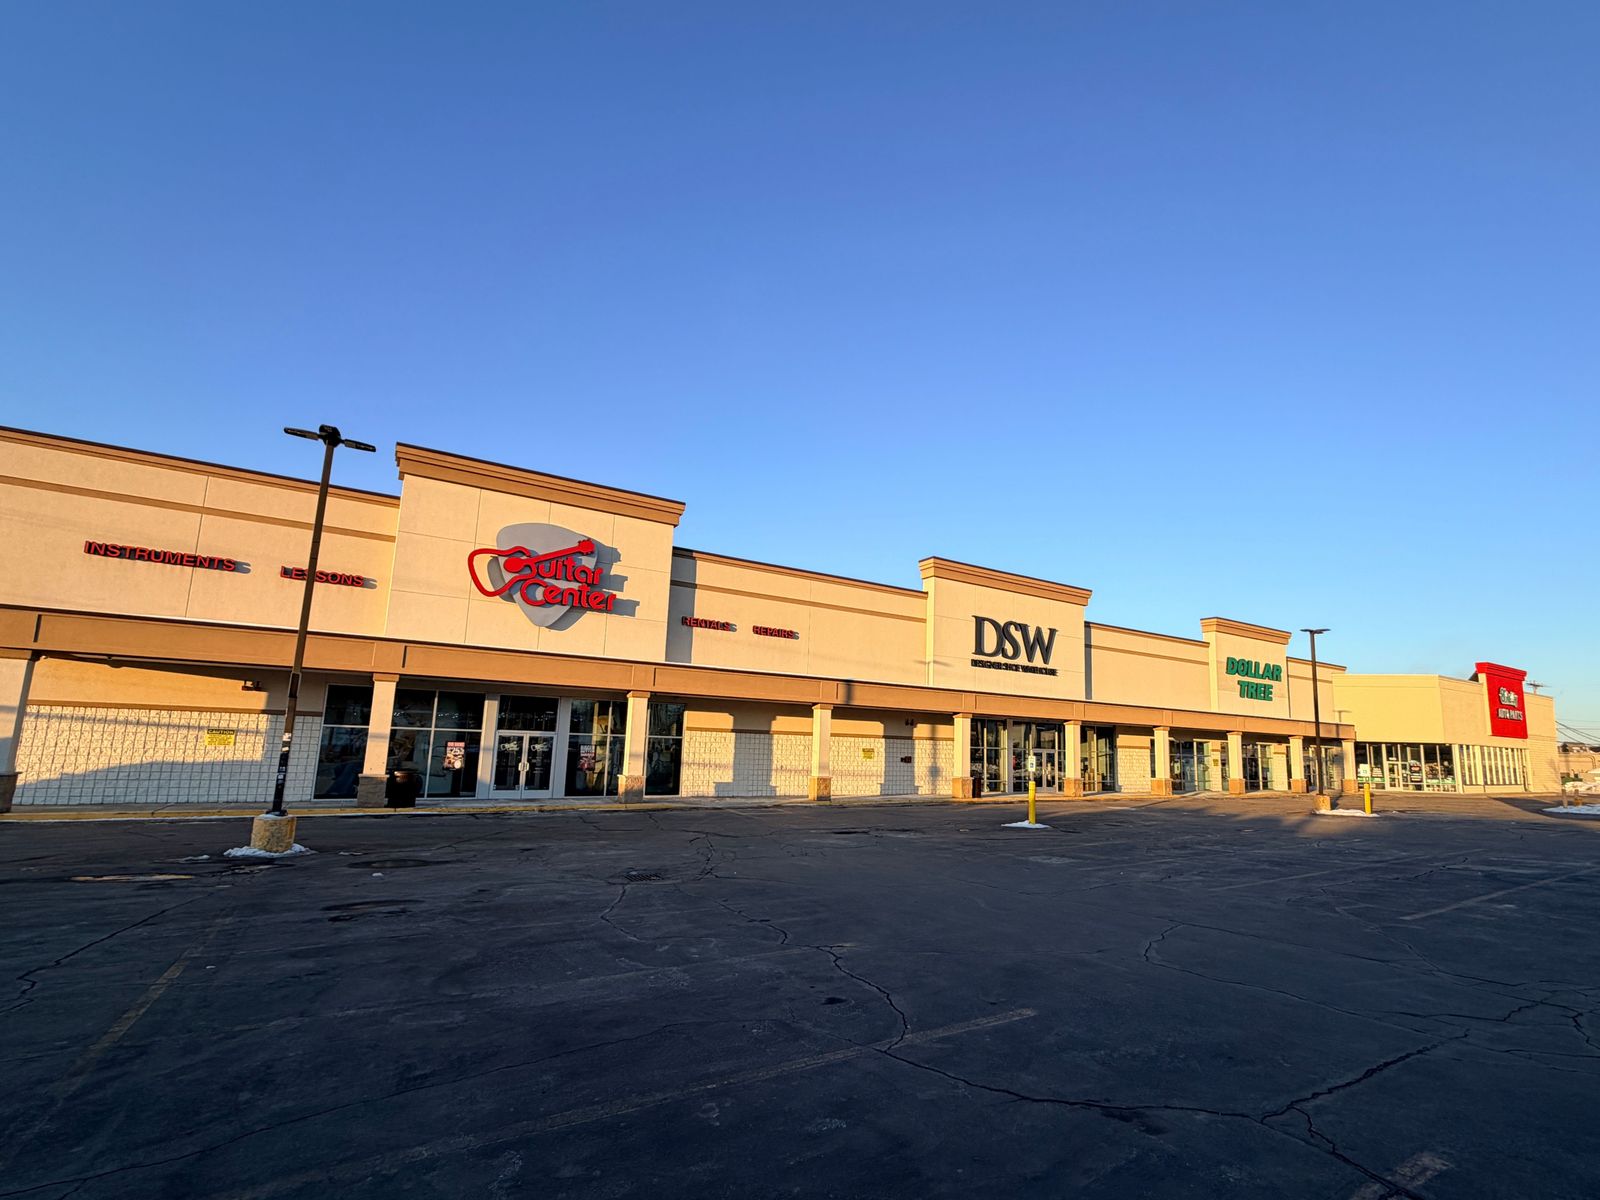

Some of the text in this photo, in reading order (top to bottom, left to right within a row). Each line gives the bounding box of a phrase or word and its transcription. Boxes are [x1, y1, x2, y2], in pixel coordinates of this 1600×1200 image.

[83, 540, 236, 572] INSTRUMENTS
[467, 538, 603, 597] Guitar
[520, 578, 616, 611] Center
[681, 615, 731, 632] RENTALS
[752, 625, 794, 639] REPAIRS
[971, 615, 1059, 665] DSW
[1225, 656, 1282, 682] DOLLAR
[1237, 680, 1273, 702] TREE
